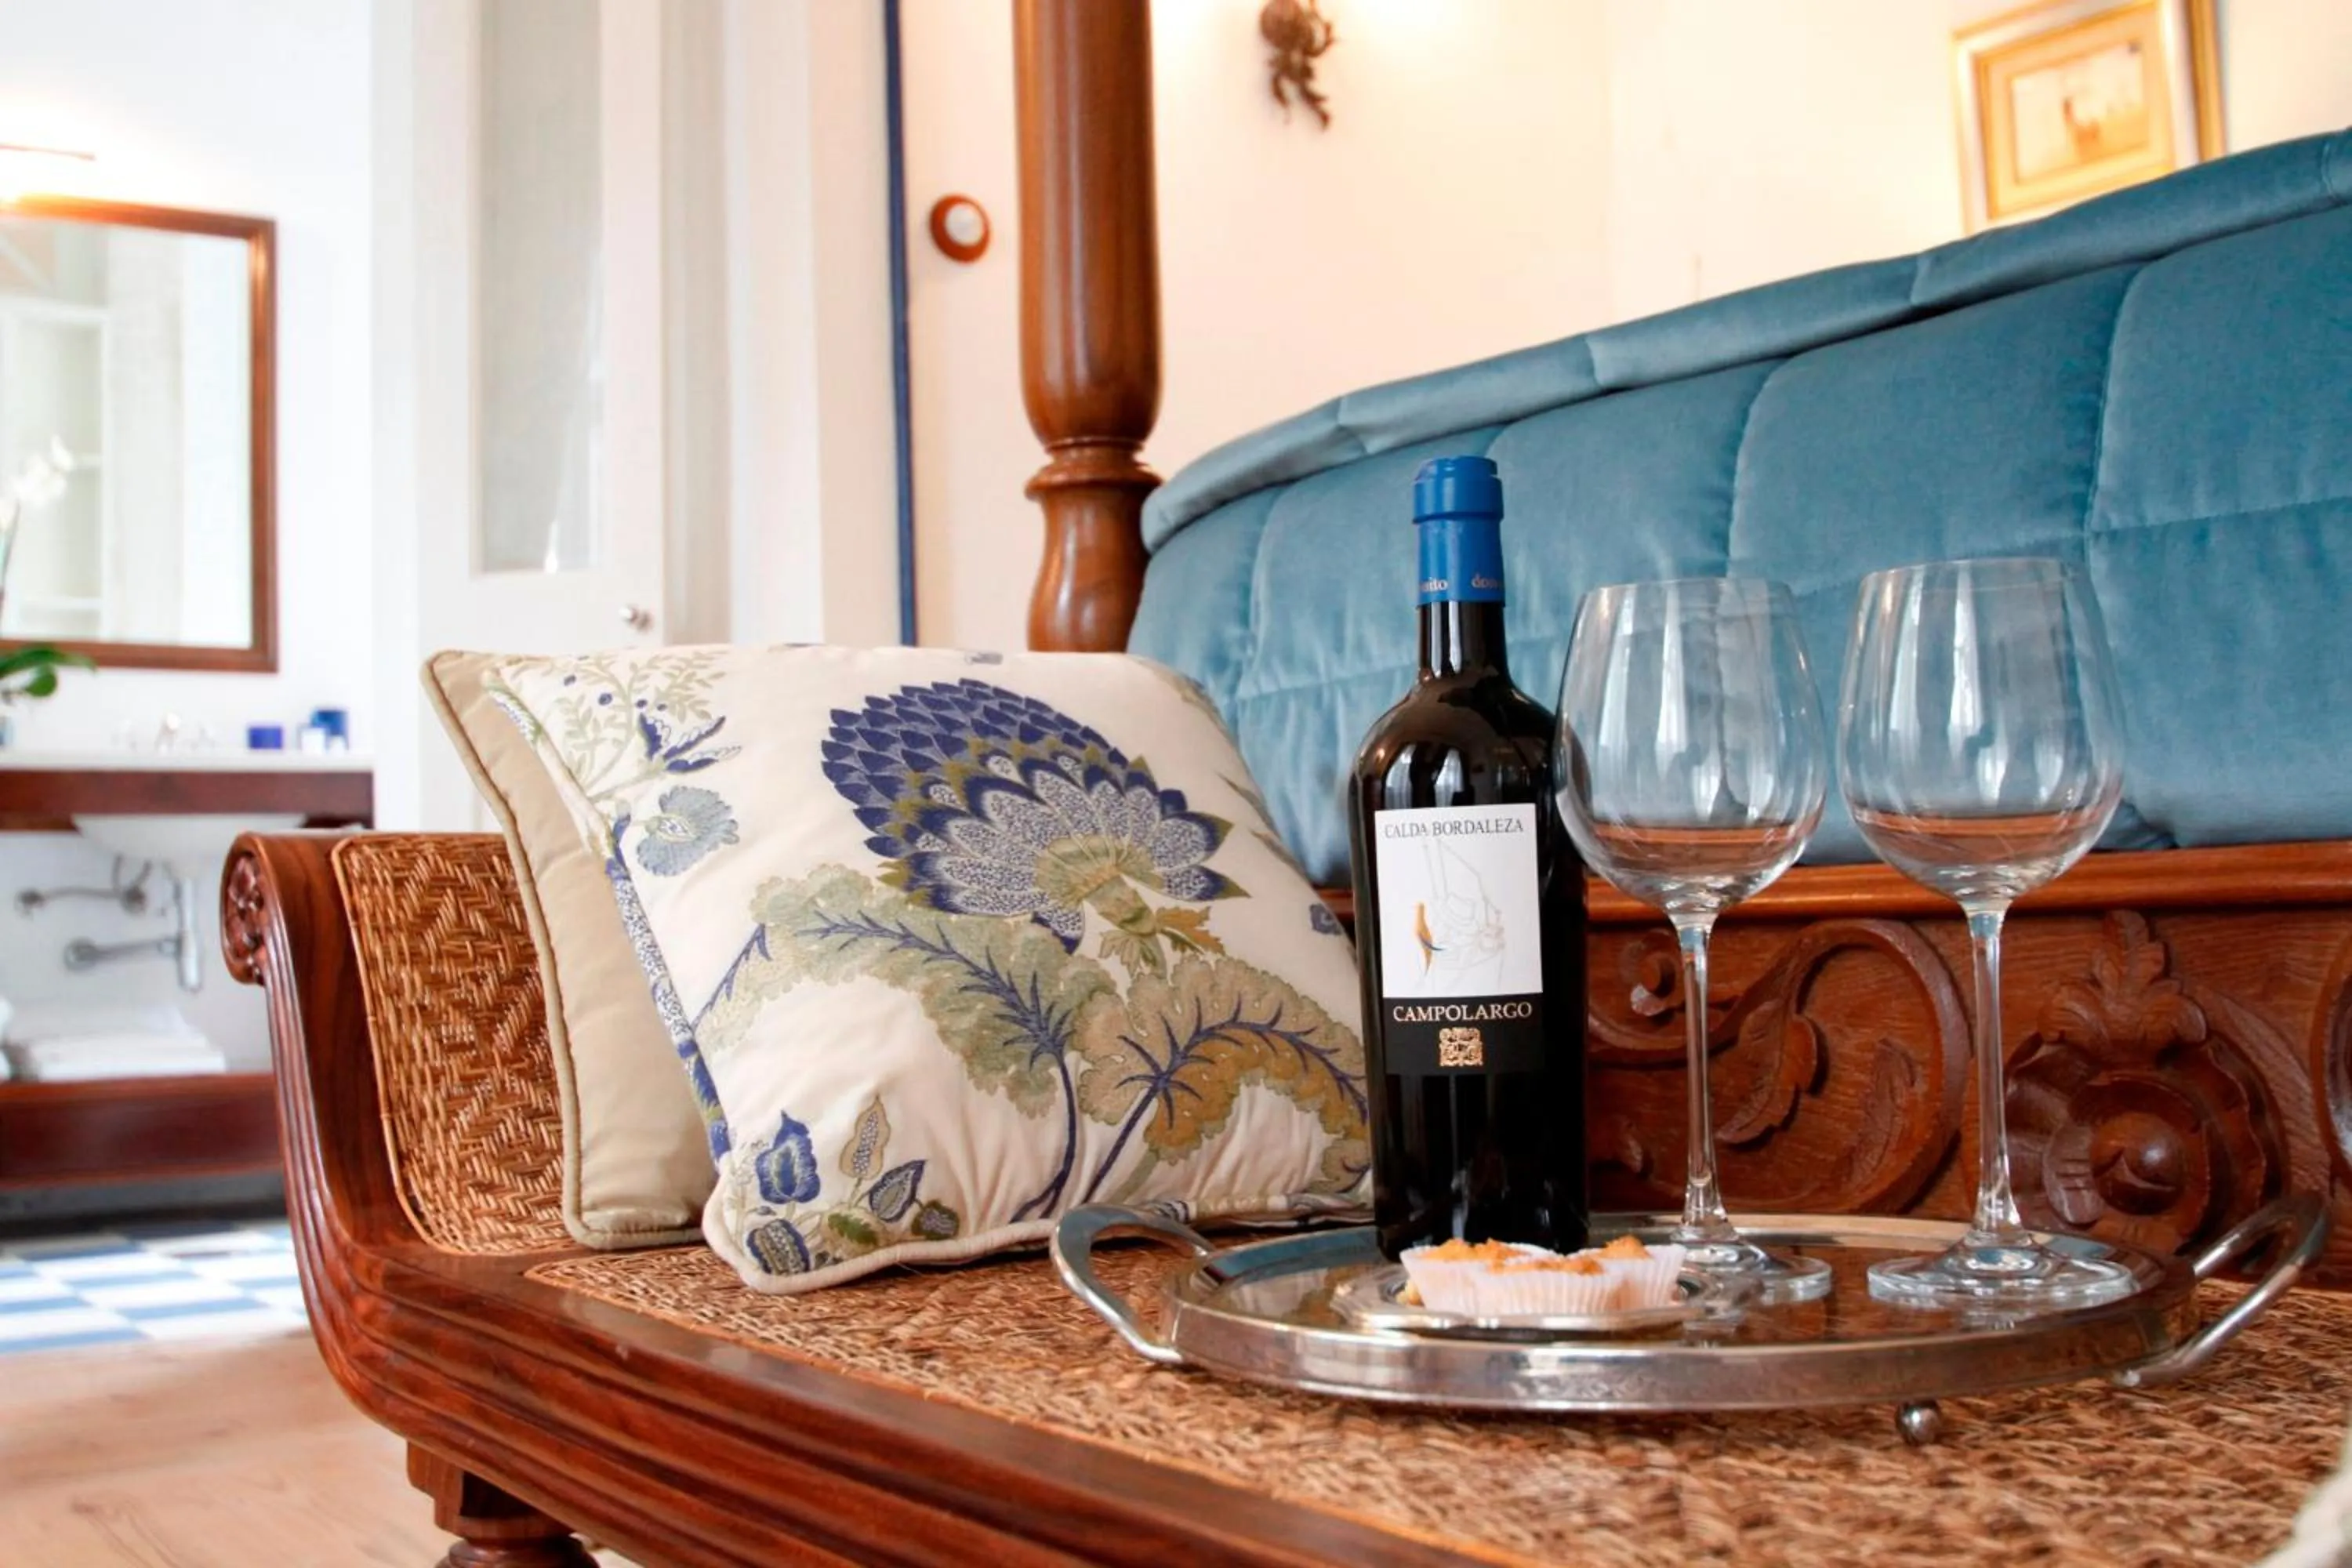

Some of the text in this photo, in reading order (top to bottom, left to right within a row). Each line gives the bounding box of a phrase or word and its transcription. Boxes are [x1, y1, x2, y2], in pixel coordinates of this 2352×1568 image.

[1385, 818, 1523, 838] CALDA BORDALEZA
[1393, 1002, 1532, 1022] CAMPOLARGO
